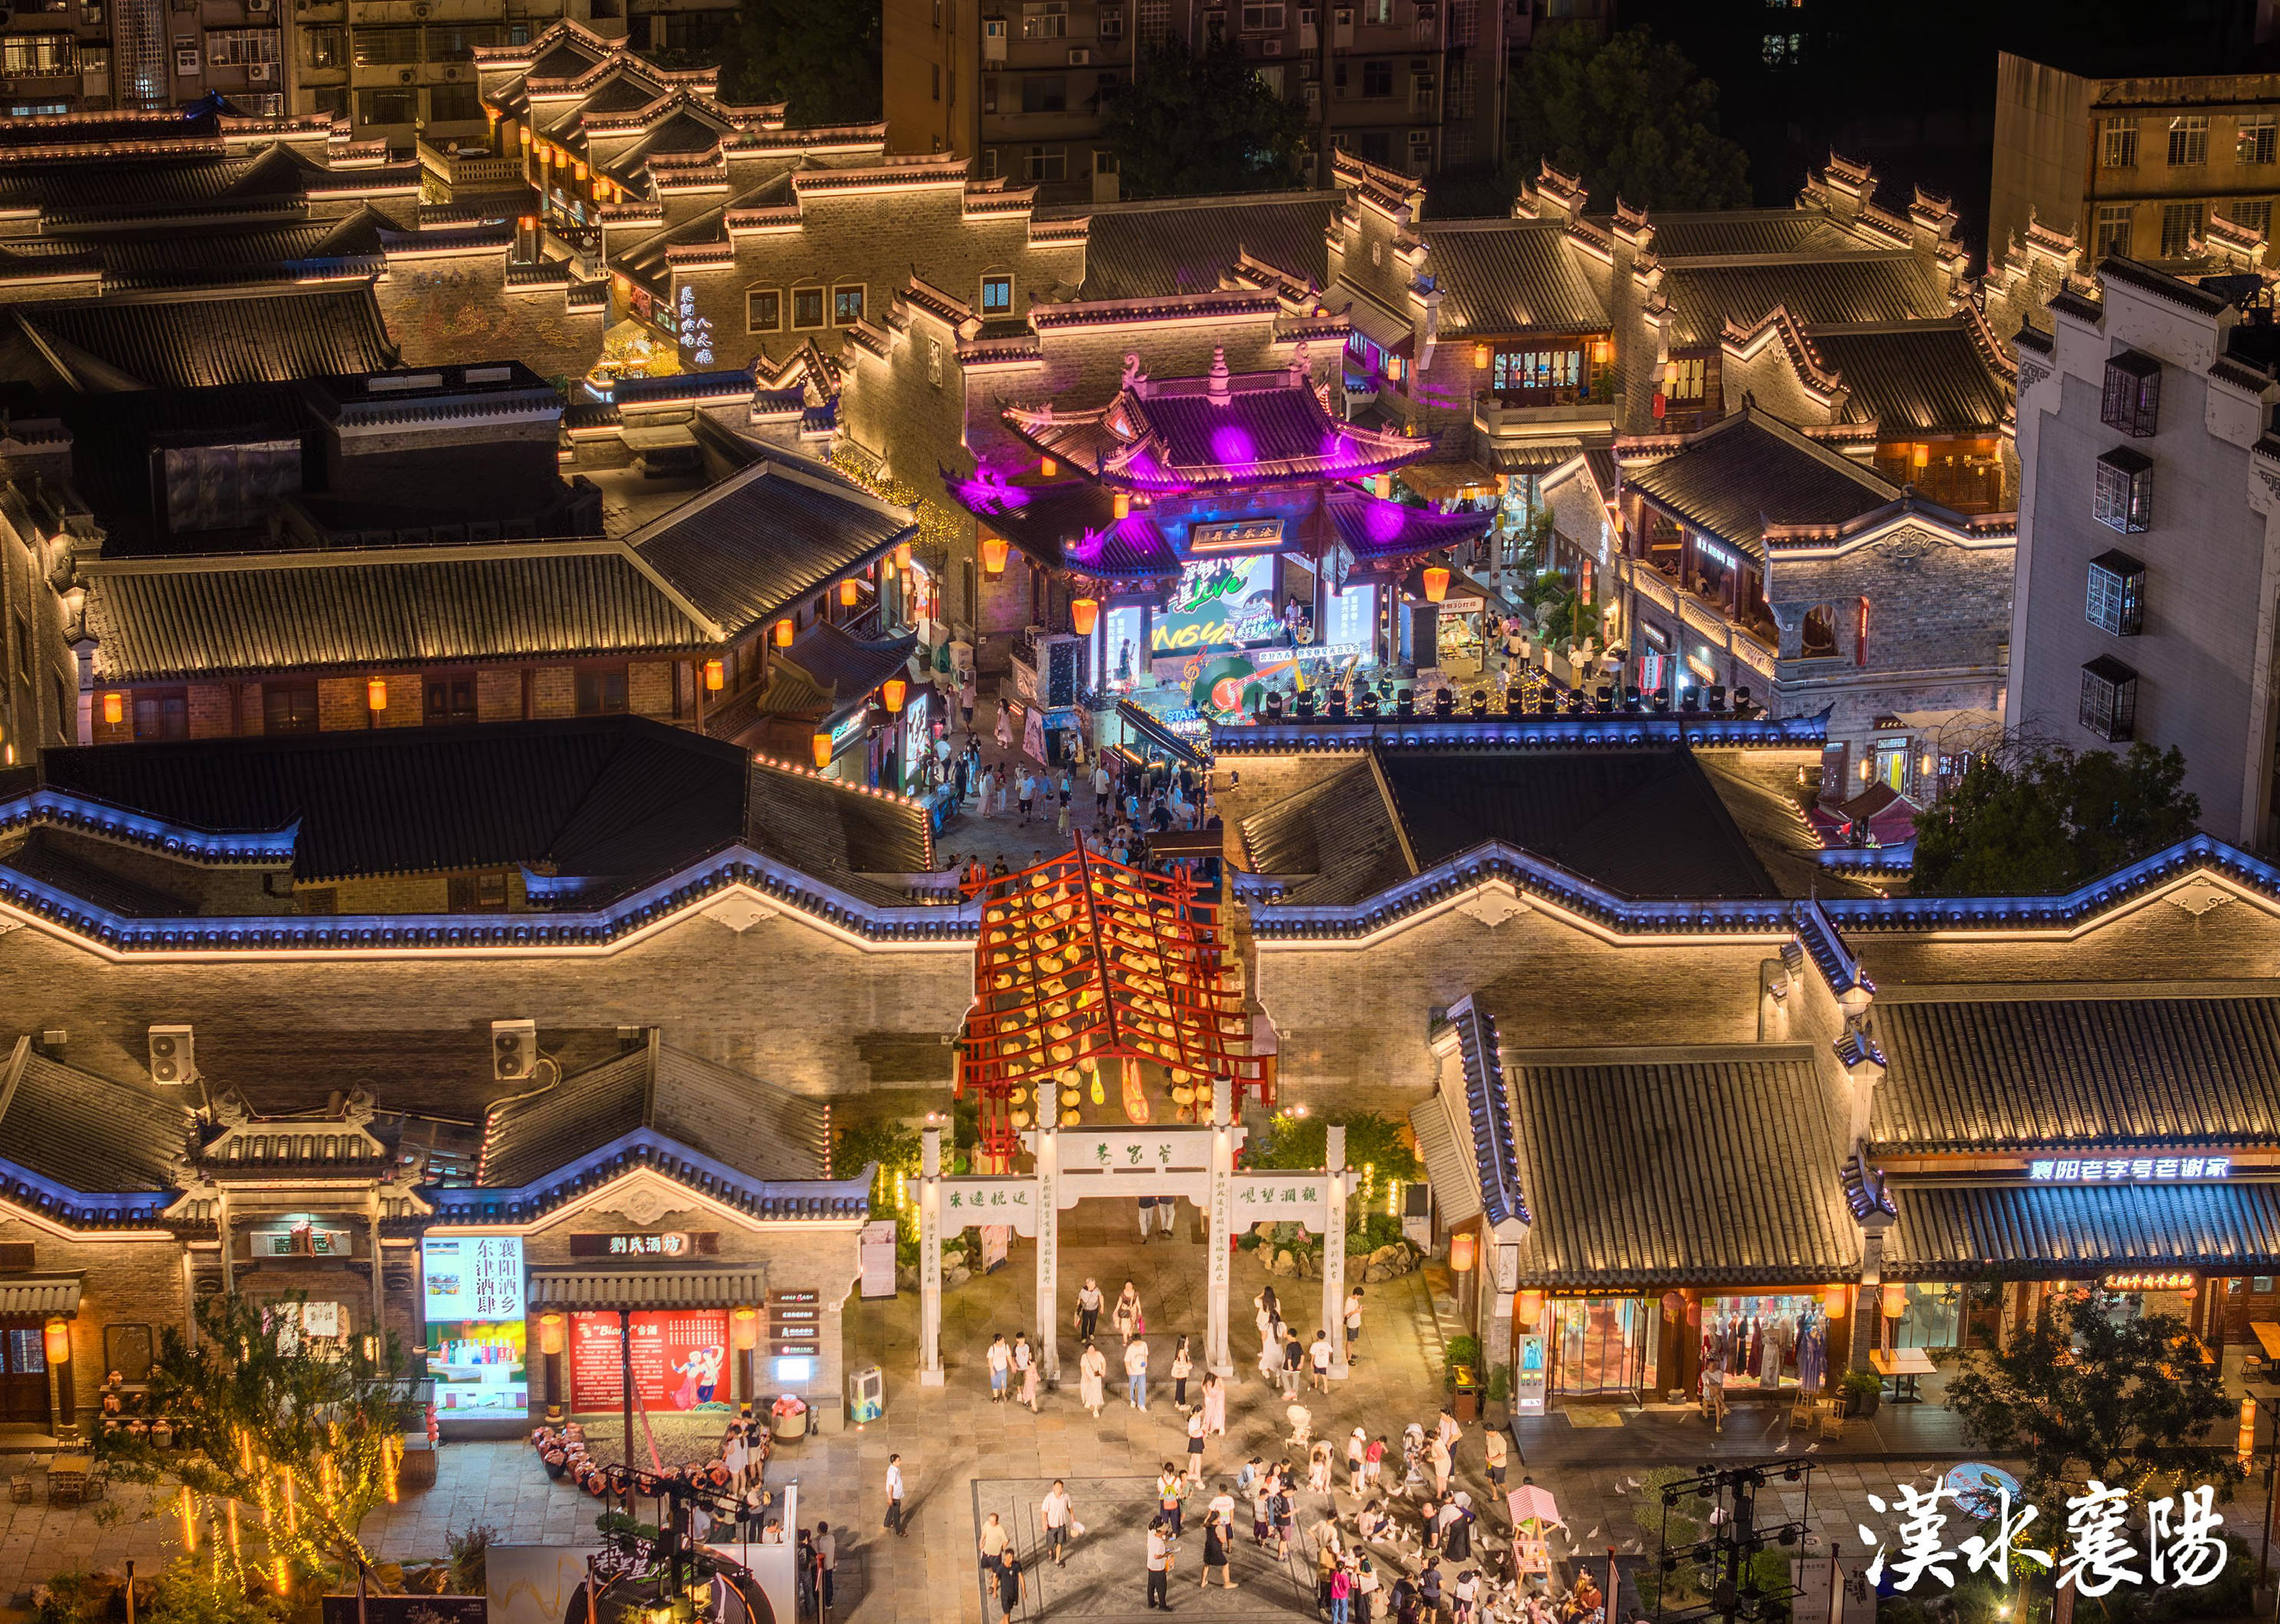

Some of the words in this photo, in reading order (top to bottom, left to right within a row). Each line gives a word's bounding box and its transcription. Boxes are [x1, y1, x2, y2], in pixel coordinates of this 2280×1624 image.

[1167, 709, 1196, 721] STAR
[2030, 1158, 2230, 1180] 襄阳老字号老谢家
[610, 1236, 681, 1254] 劉氏酒坊
[476, 1239, 496, 1315] 东津酒肆
[498, 1239, 517, 1314] 襄阳酒乡
